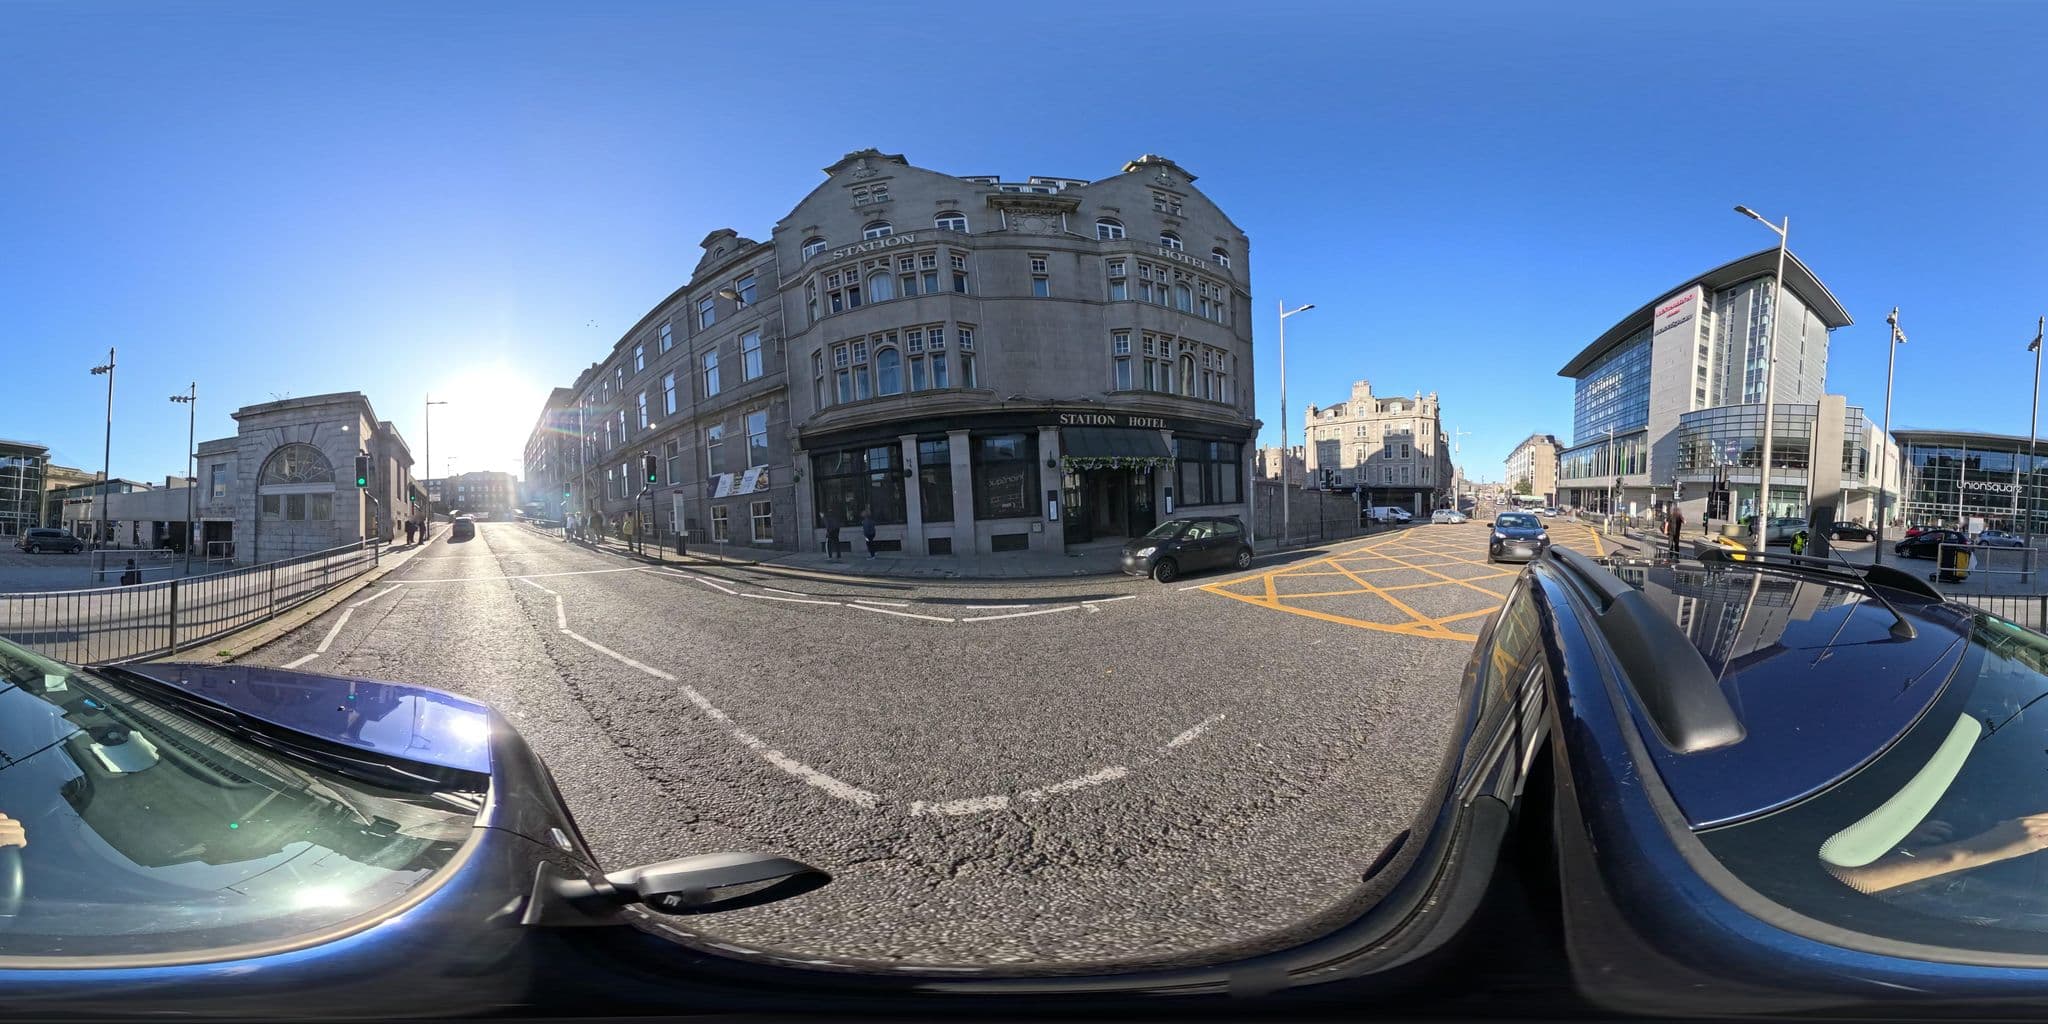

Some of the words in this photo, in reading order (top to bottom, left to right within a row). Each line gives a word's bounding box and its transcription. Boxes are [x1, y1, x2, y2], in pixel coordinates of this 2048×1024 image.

[833, 234, 915, 260] STATION
[1158, 247, 1210, 271] HOTEL
[1060, 413, 1116, 425] STATION
[1129, 416, 1167, 428] HOTEL
